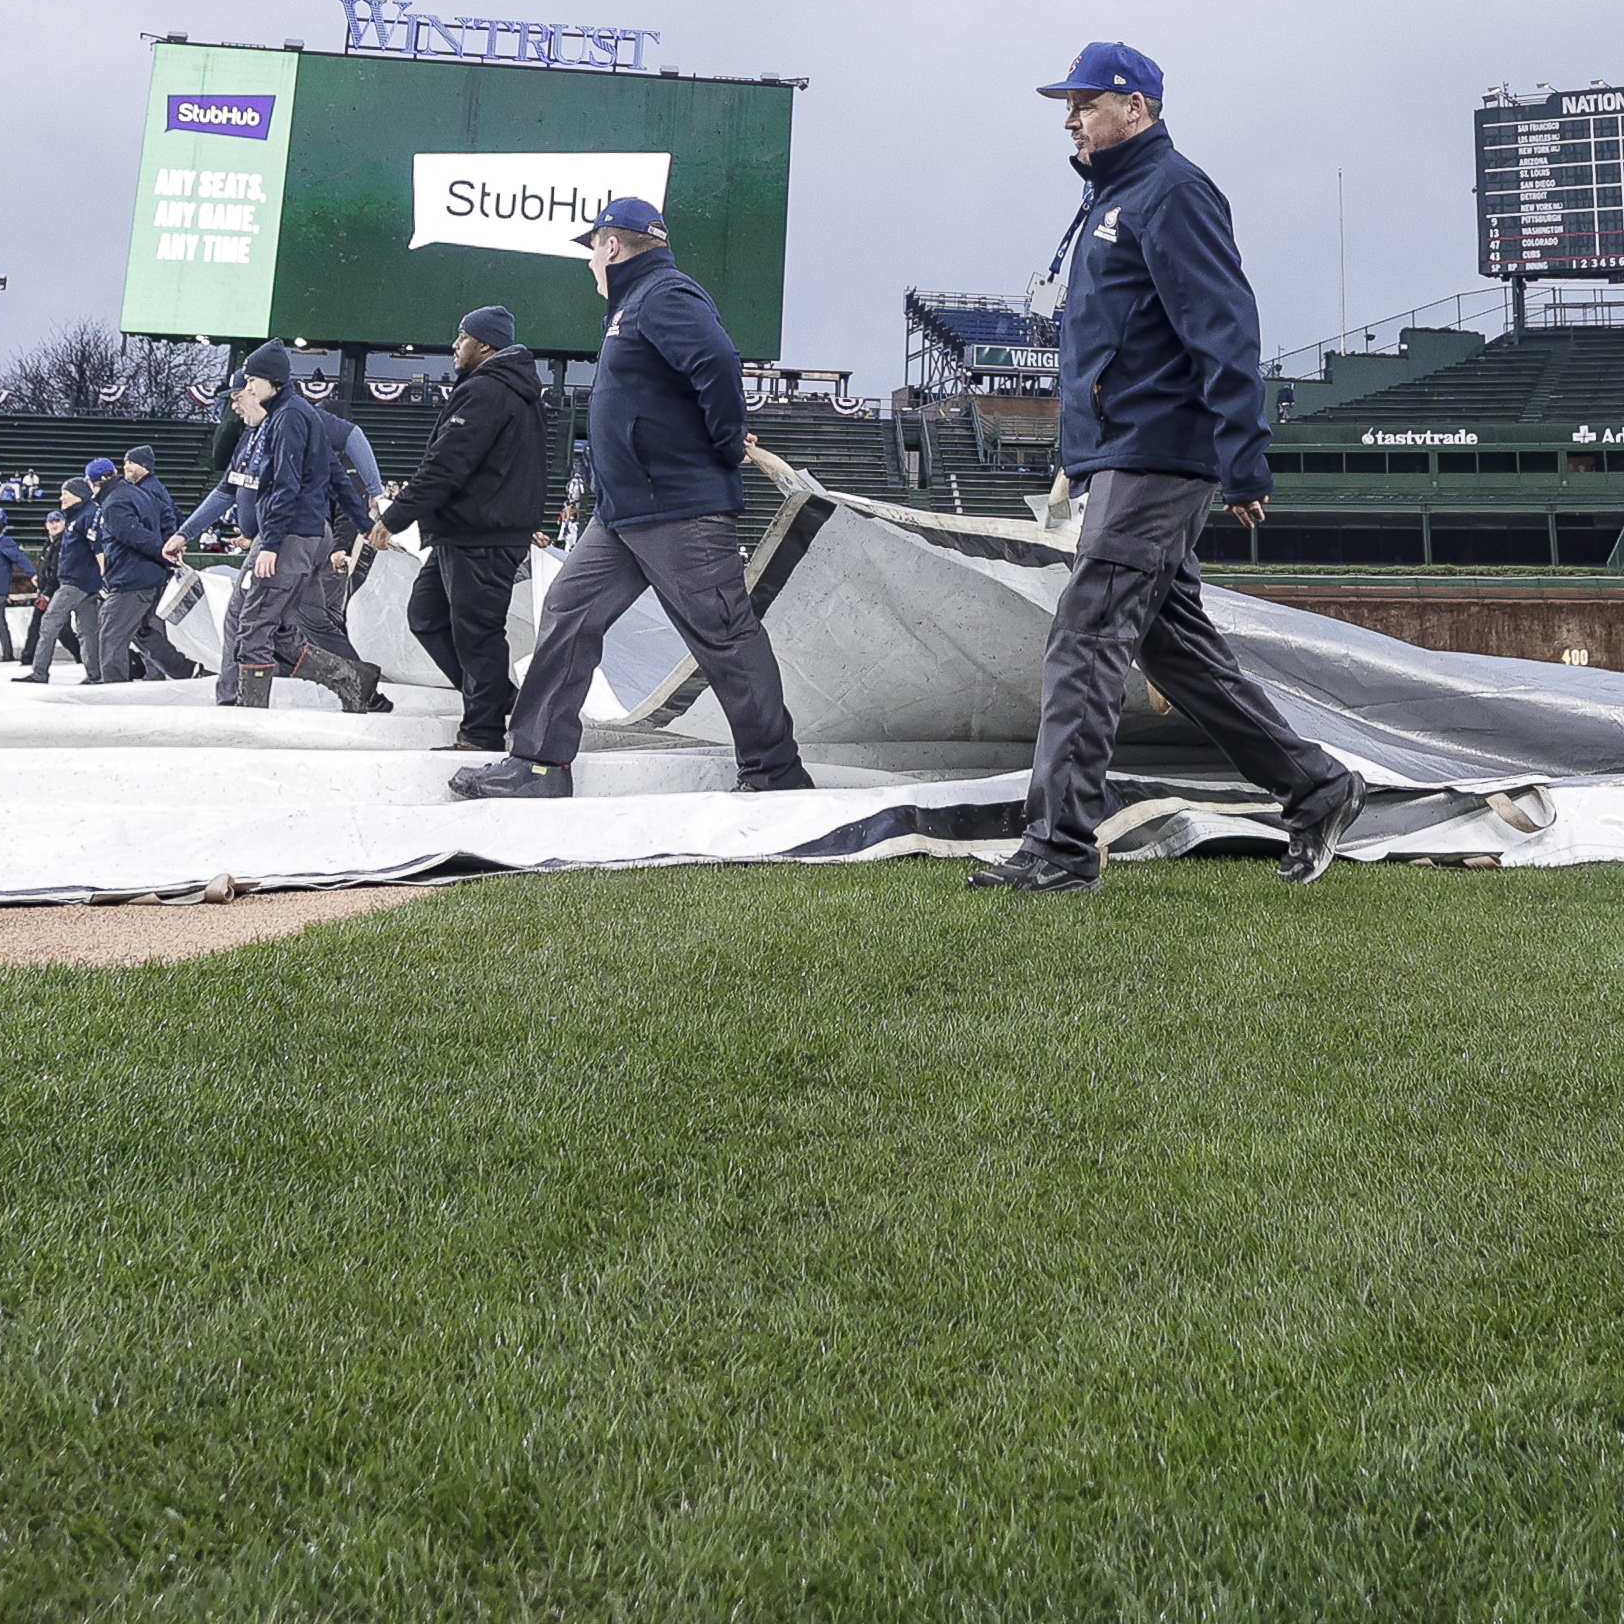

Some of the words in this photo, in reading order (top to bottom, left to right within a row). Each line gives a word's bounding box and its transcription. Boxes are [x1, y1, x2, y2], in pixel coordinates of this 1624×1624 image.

[177, 102, 261, 126] StubHub
[1519, 157, 1548, 166] ARIZONA
[1530, 168, 1550, 177] LOUIS
[154, 169, 197, 196] ANY
[198, 171, 267, 203] SEATS,
[1520, 180, 1533, 189] SAN
[1535, 179, 1556, 188] DIEGO
[446, 179, 612, 223] StubHu
[153, 200, 196, 228] ANY
[1491, 218, 1498, 226] 9
[1521, 214, 1562, 224] PITTSBURGH
[1489, 229, 1500, 238] 13
[1522, 225, 1564, 235] WASHINGTON
[156, 233, 199, 261] ANY
[202, 235, 252, 264] TIME
[1489, 240, 1500, 249] 47
[1522, 237, 1558, 247] COLORADO
[1489, 251, 1501, 261] 43
[1572, 259, 1577, 269] 1
[1580, 259, 1588, 269] 2
[1591, 258, 1598, 268] 3
[1599, 258, 1607, 267] 4
[1609, 257, 1616, 267] 5
[1376, 429, 1477, 445] tastytrade
[1561, 648, 1589, 665] 400
